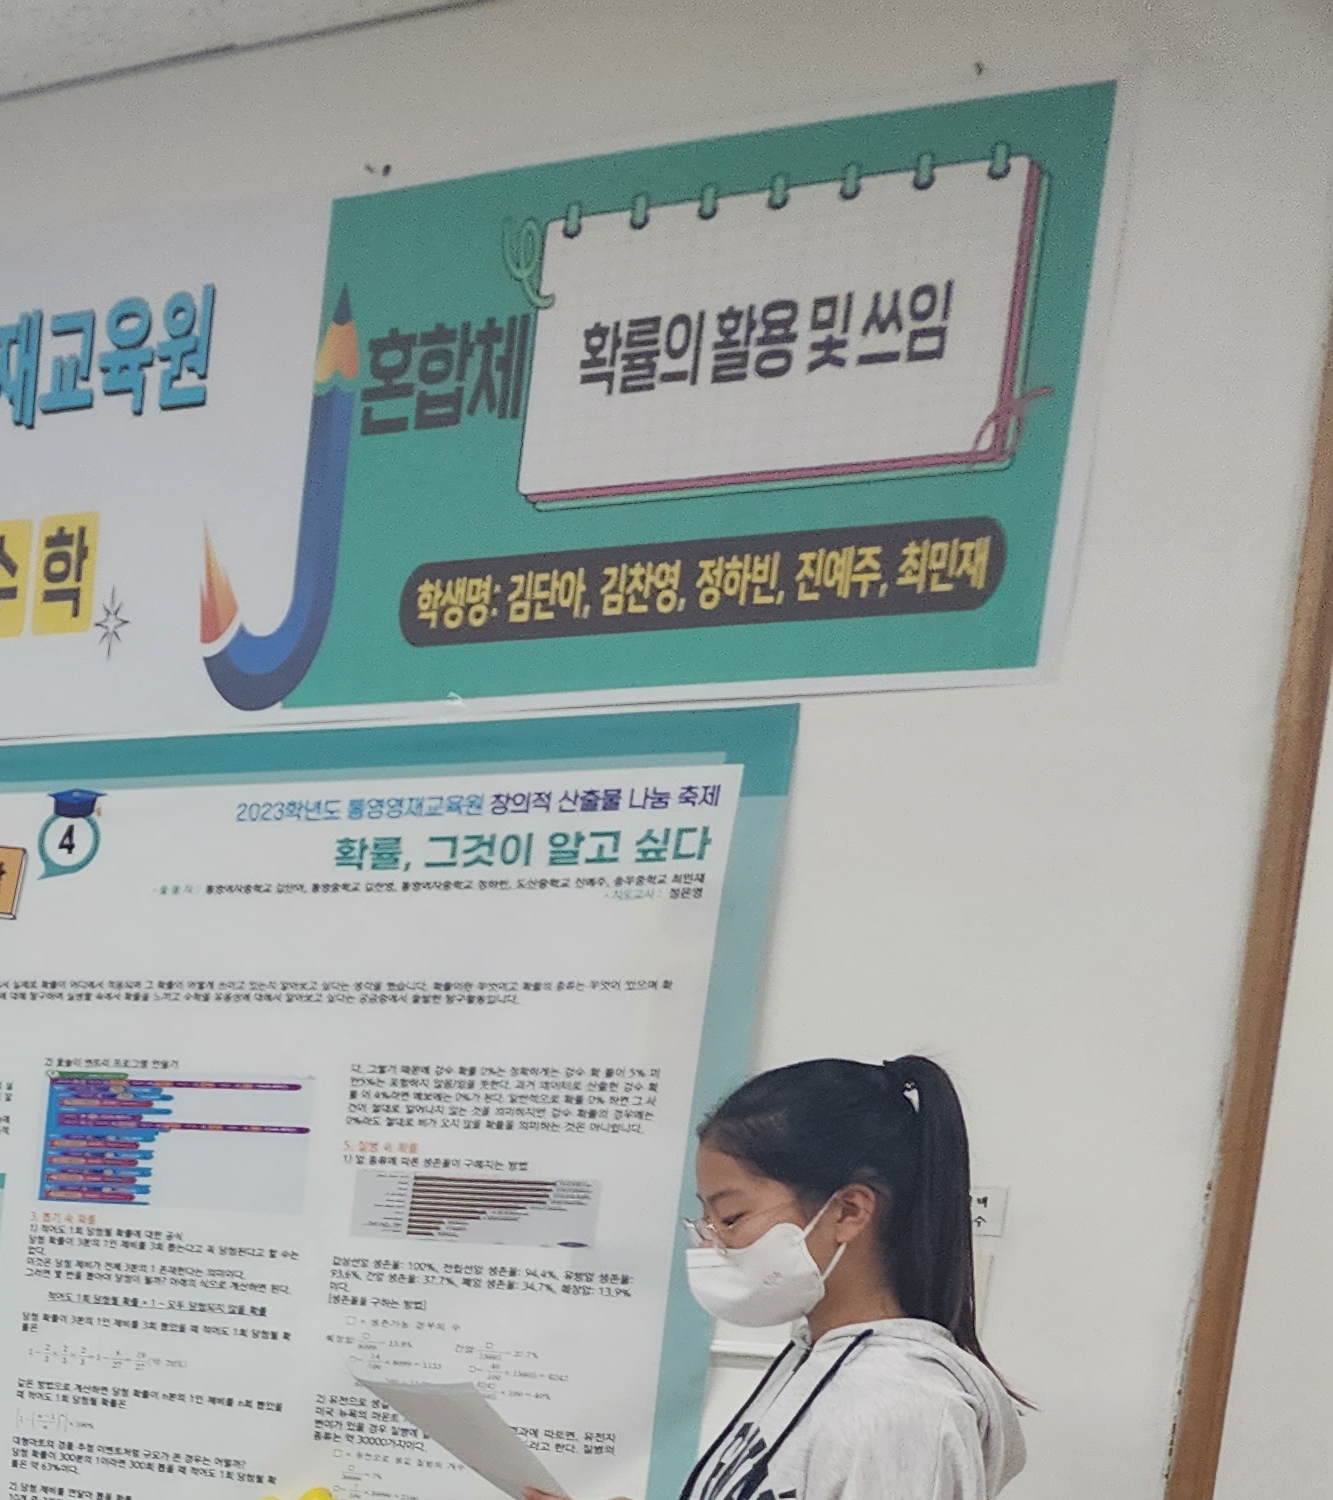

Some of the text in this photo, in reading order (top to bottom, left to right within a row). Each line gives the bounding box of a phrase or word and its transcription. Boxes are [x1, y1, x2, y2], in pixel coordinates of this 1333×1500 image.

[360, 279, 955, 436] 혼합체 확률의 활용 및 쓰임
[417, 535, 993, 630] 학생명: 김단아, 김찬영, 정하빈, 진예주, 최민재
[491, 791, 551, 814] 창의적
[558, 788, 621, 813] 산출물
[629, 787, 670, 810] 나눔
[678, 785, 720, 806] 축제
[58, 823, 76, 855] 4
[335, 826, 710, 872] 확률, 그것이 알고 싶다
